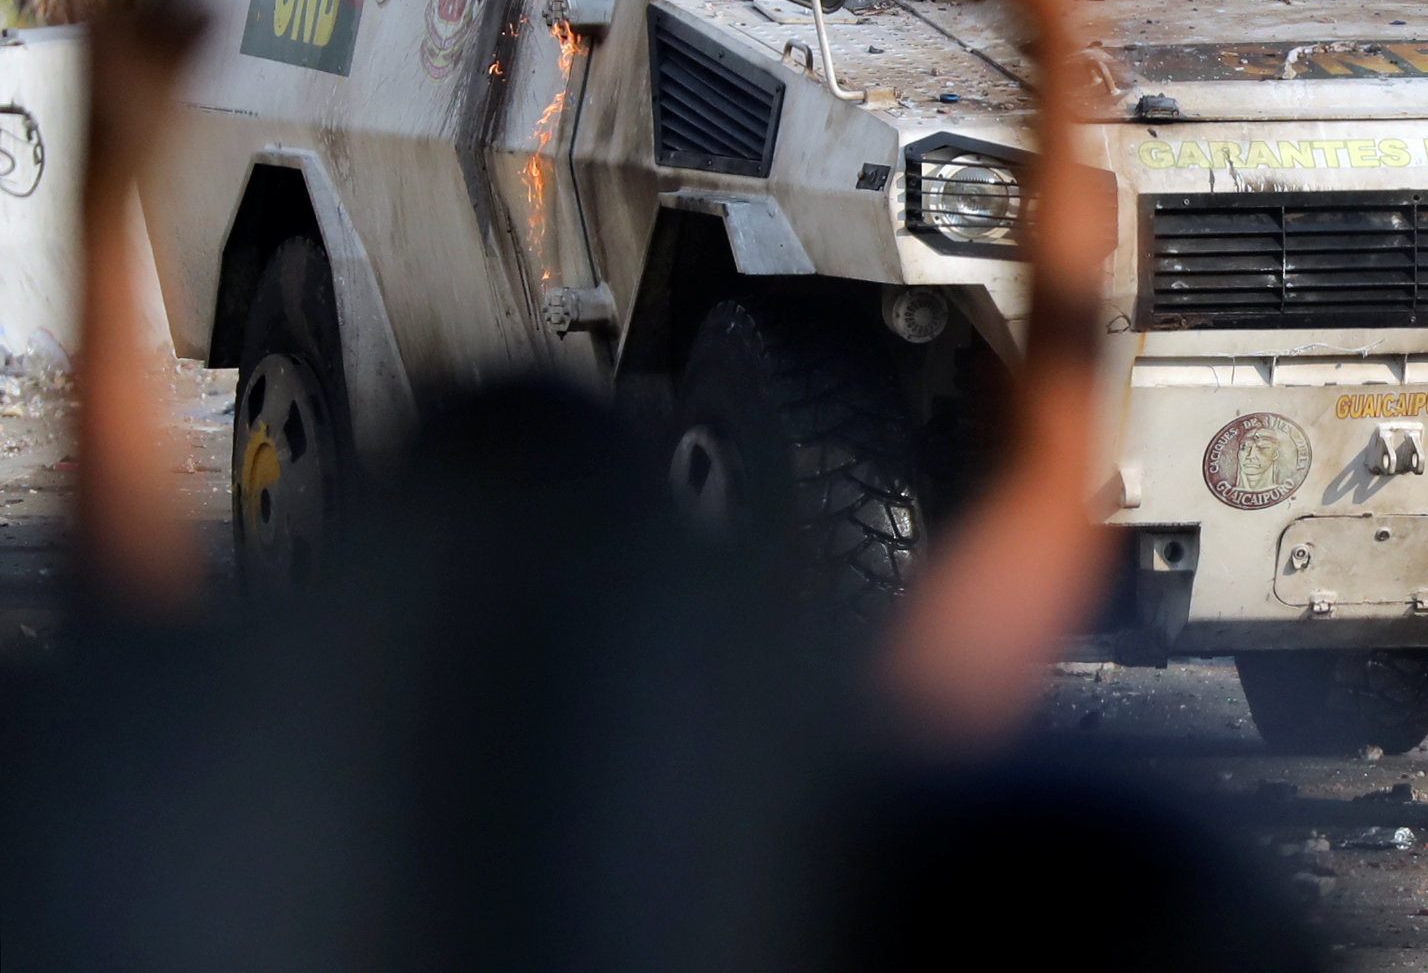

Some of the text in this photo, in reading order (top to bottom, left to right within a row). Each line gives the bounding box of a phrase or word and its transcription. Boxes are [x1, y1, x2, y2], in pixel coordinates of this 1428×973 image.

[1137, 138, 1412, 170] GARANTES
[1209, 428, 1238, 474] CACIQUES
[1243, 418, 1260, 429] DE
[1216, 478, 1295, 505] GUAICAIPURO
